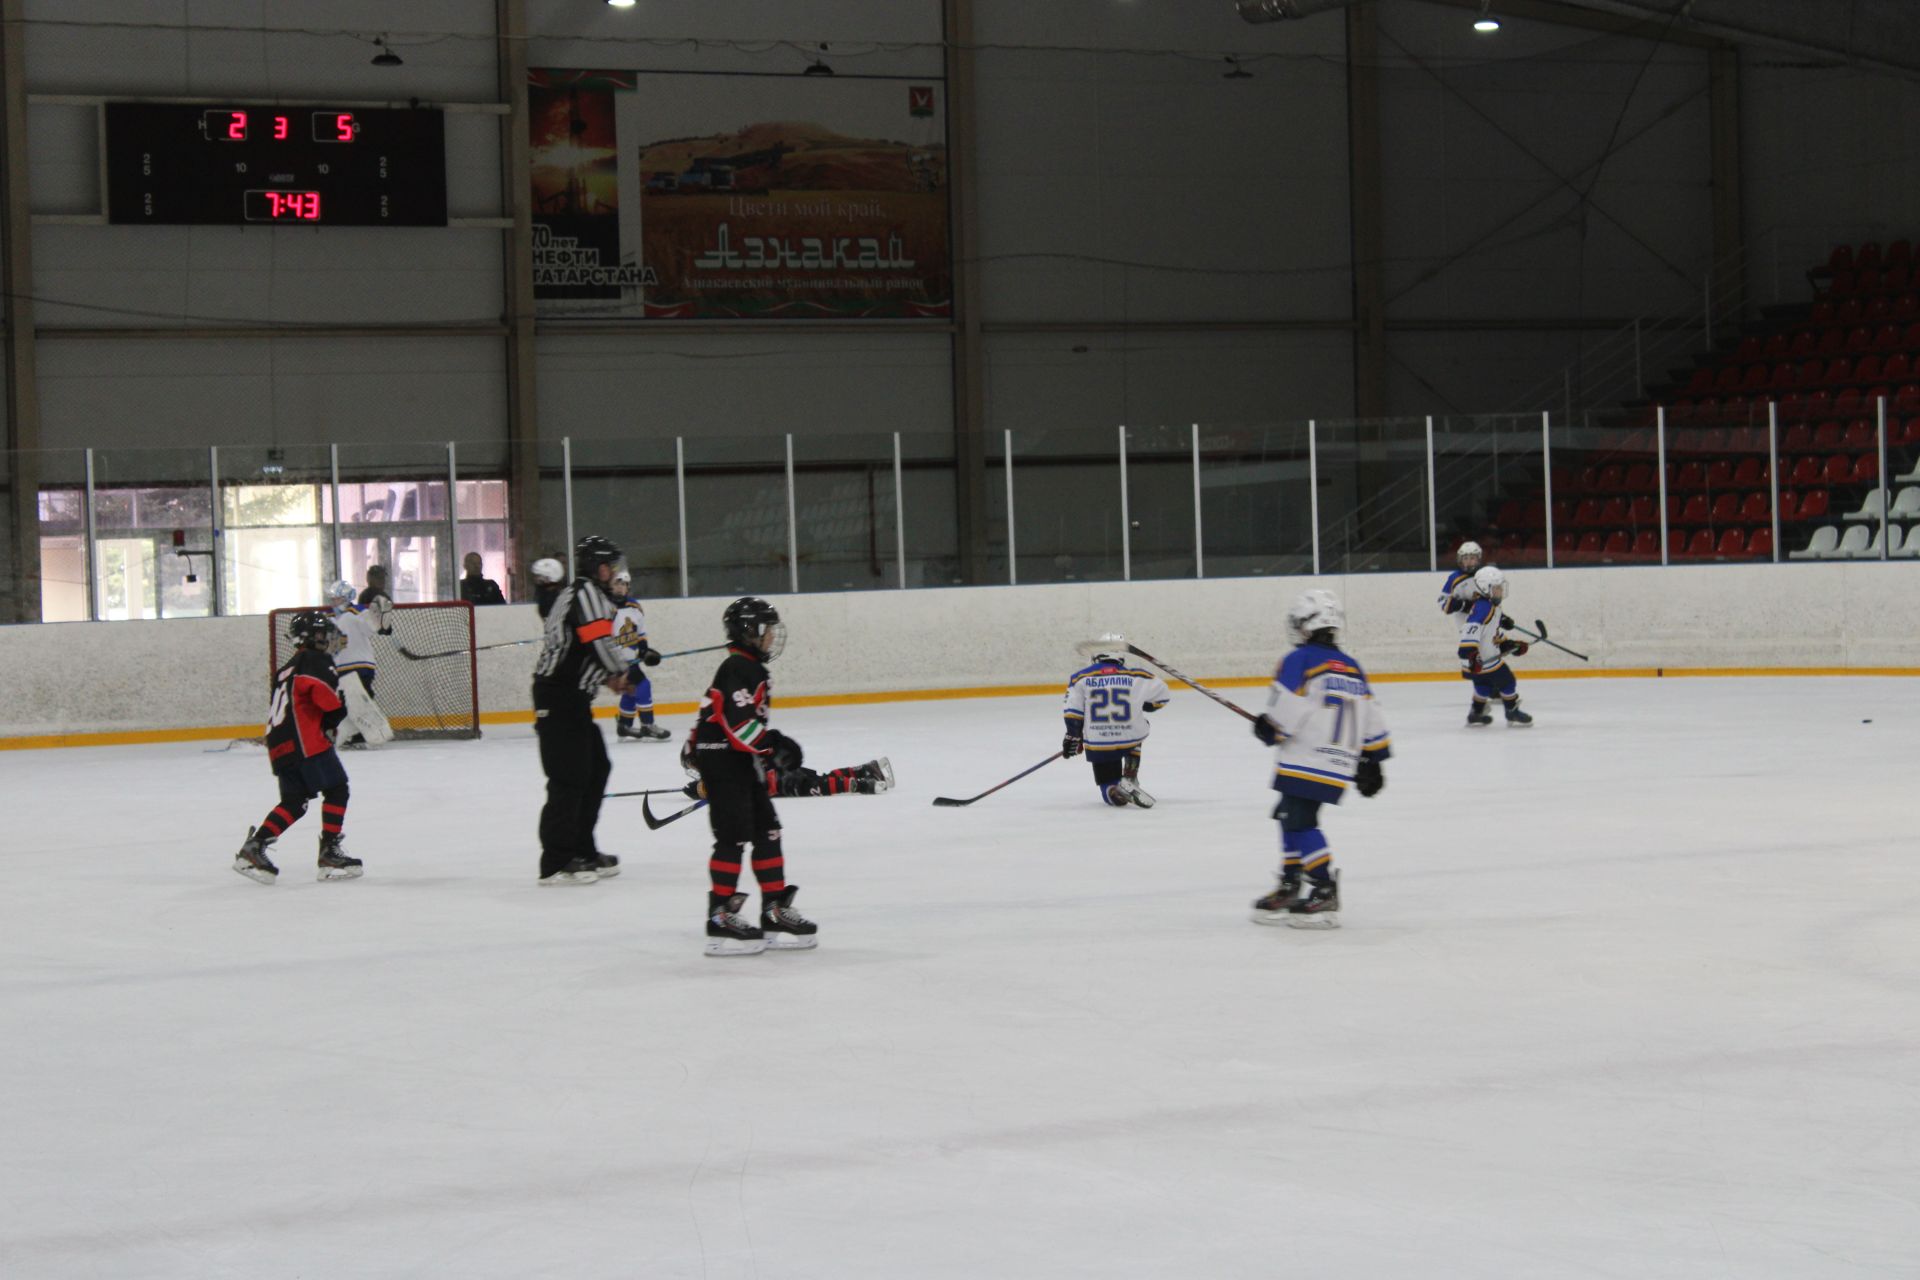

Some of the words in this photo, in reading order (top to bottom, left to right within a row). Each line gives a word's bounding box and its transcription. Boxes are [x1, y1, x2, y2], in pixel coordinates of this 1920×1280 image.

[229, 112, 248, 139] 2
[273, 116, 288, 139] 3
[337, 114, 353, 141] 5
[235, 162, 247, 173] 10
[317, 164, 329, 174] 10
[265, 192, 319, 219] 7:43
[728, 197, 788, 218] Цвети
[793, 198, 831, 217] мой
[550, 238, 577, 249] лет
[532, 249, 599, 265] НЕФТИ
[533, 267, 657, 284] ТАТАРСТАНА
[1086, 676, 1133, 688] АБДУЛЛИН
[1090, 688, 1131, 722] 25
